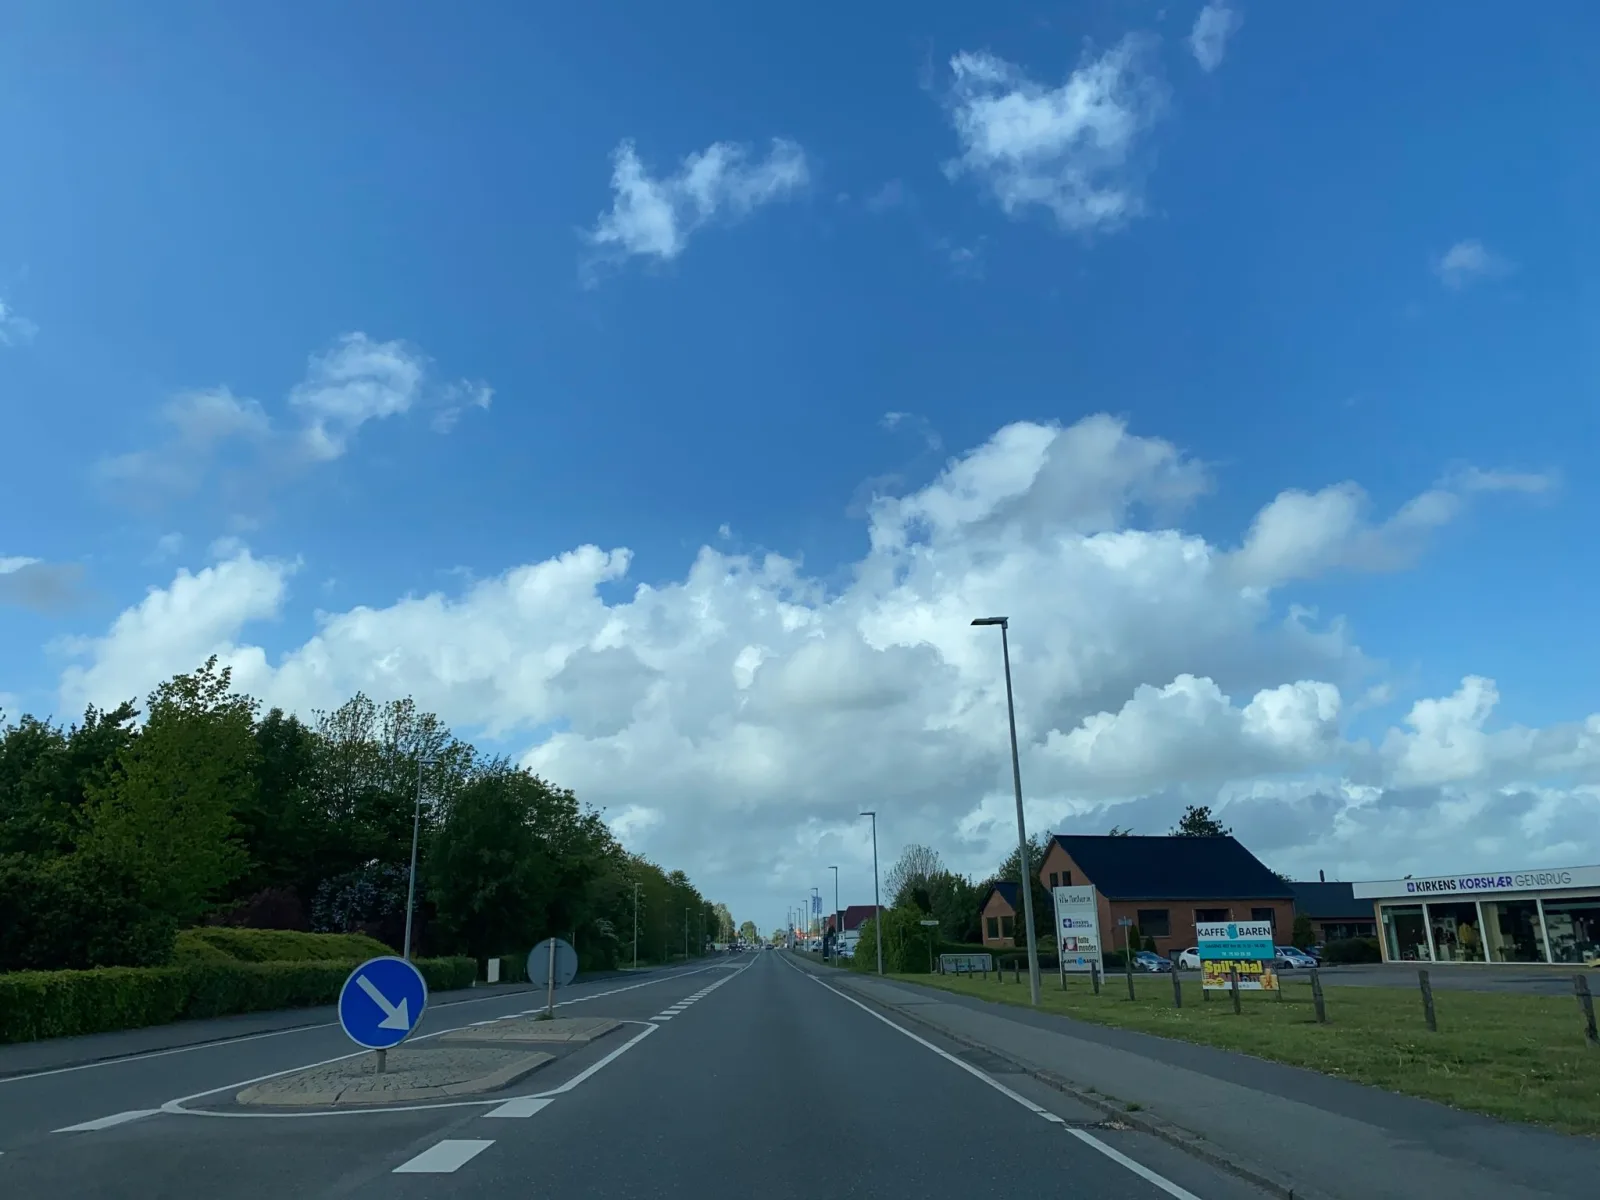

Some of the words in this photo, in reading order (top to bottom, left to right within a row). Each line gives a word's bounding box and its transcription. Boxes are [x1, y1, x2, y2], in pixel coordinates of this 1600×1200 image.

[1416, 879, 1456, 892] KIRKENS
[1459, 876, 1513, 889] KORSHÆR
[1515, 872, 1571, 887] GENBRUG
[1197, 928, 1226, 937] KAFFE
[1239, 927, 1271, 936] BAREN
